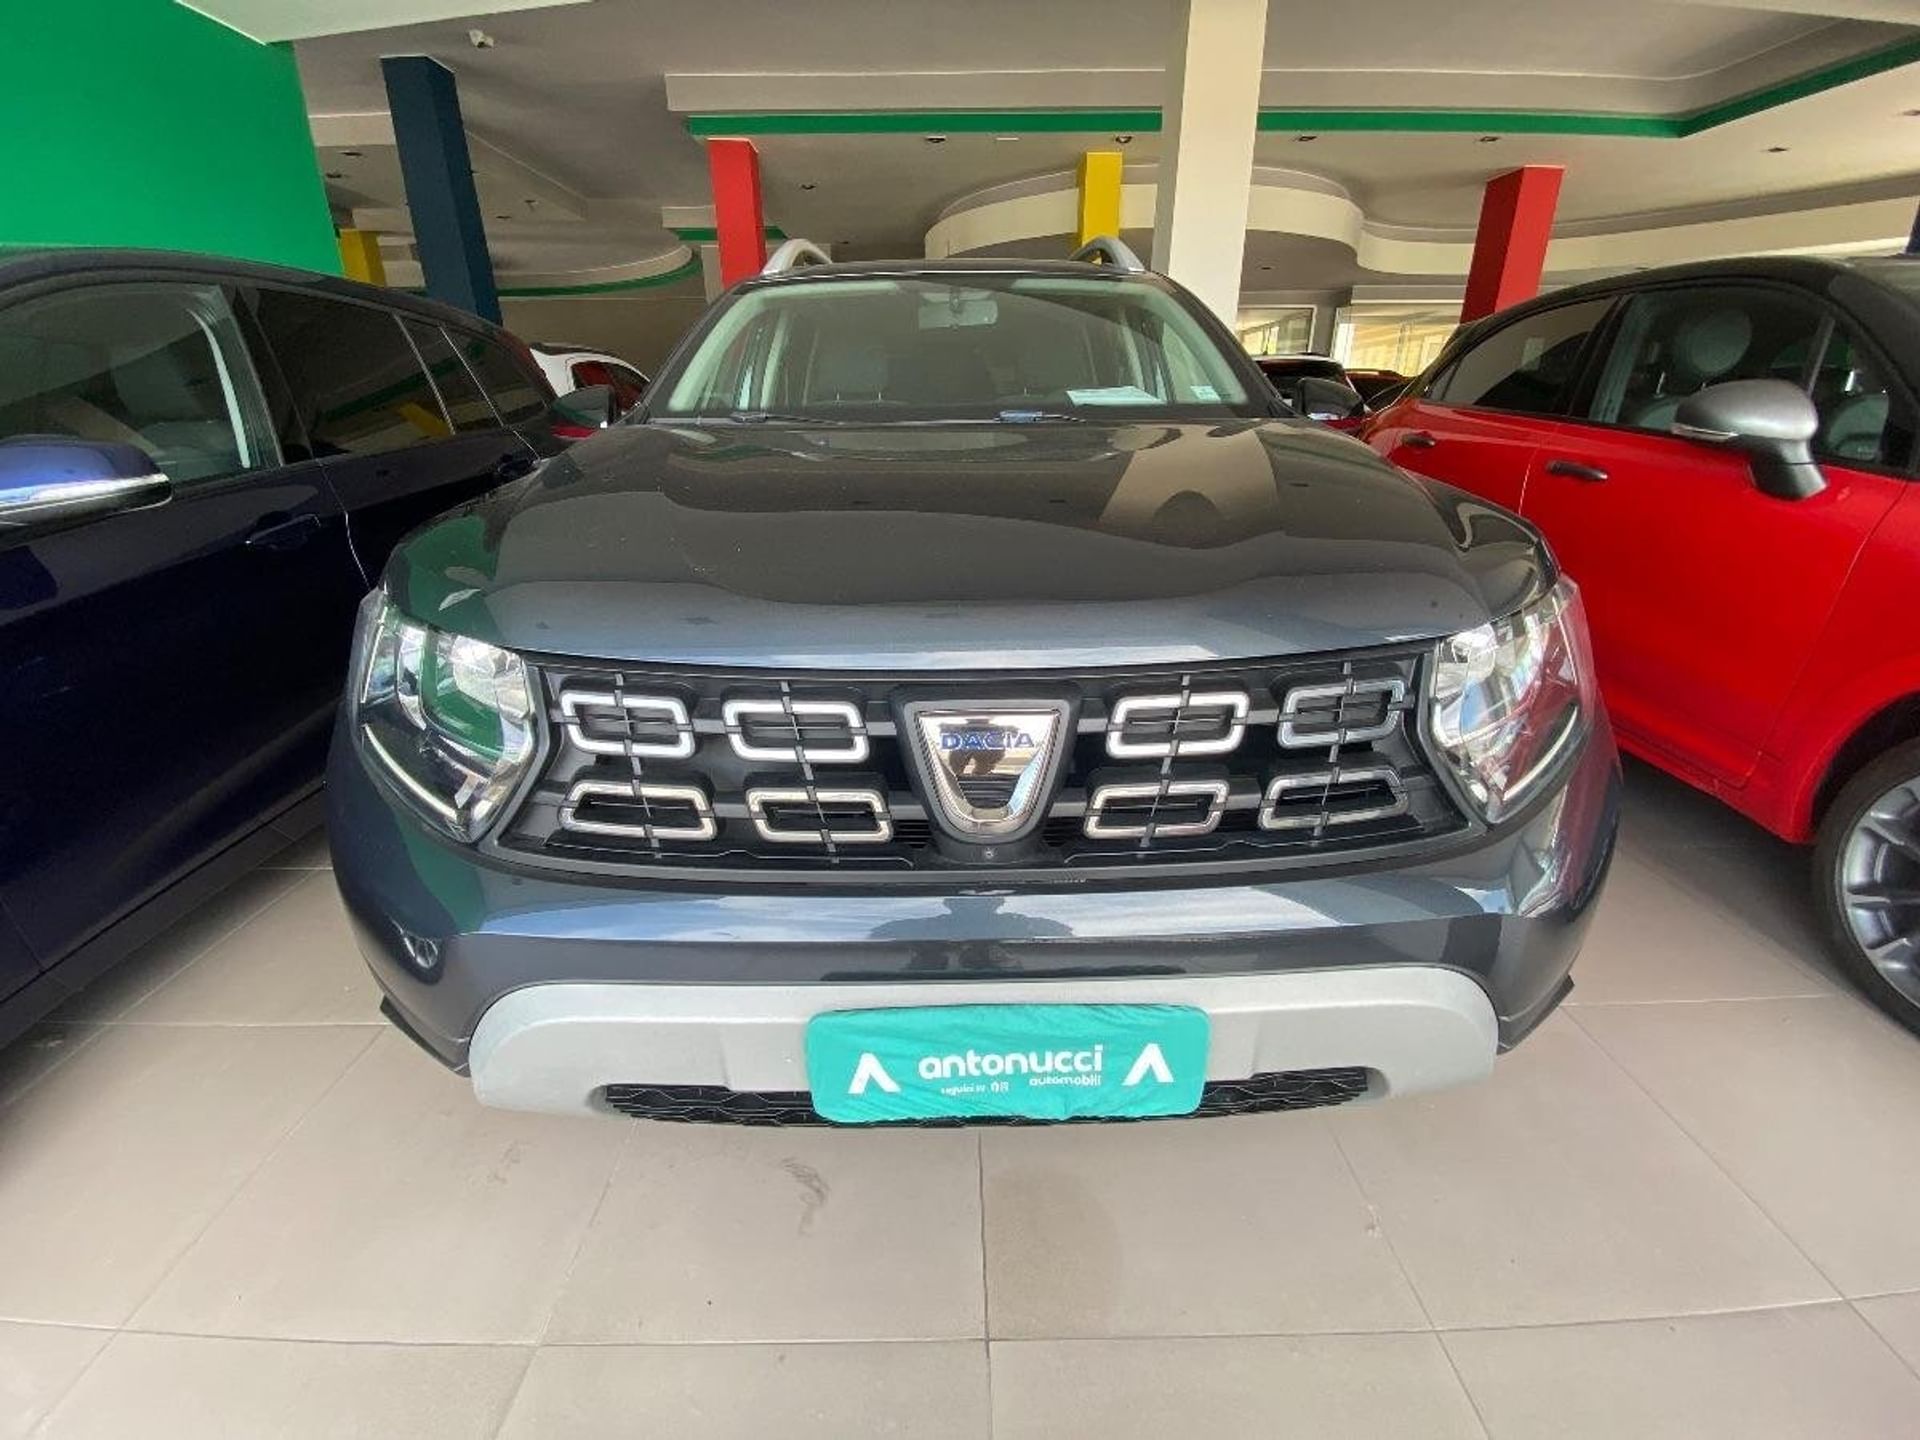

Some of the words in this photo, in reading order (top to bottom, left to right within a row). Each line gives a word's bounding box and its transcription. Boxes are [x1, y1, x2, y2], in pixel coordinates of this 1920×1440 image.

[940, 732, 1034, 750] DACIA
[918, 1044, 1103, 1079] antonucci
[1029, 1074, 1102, 1086] automobili
